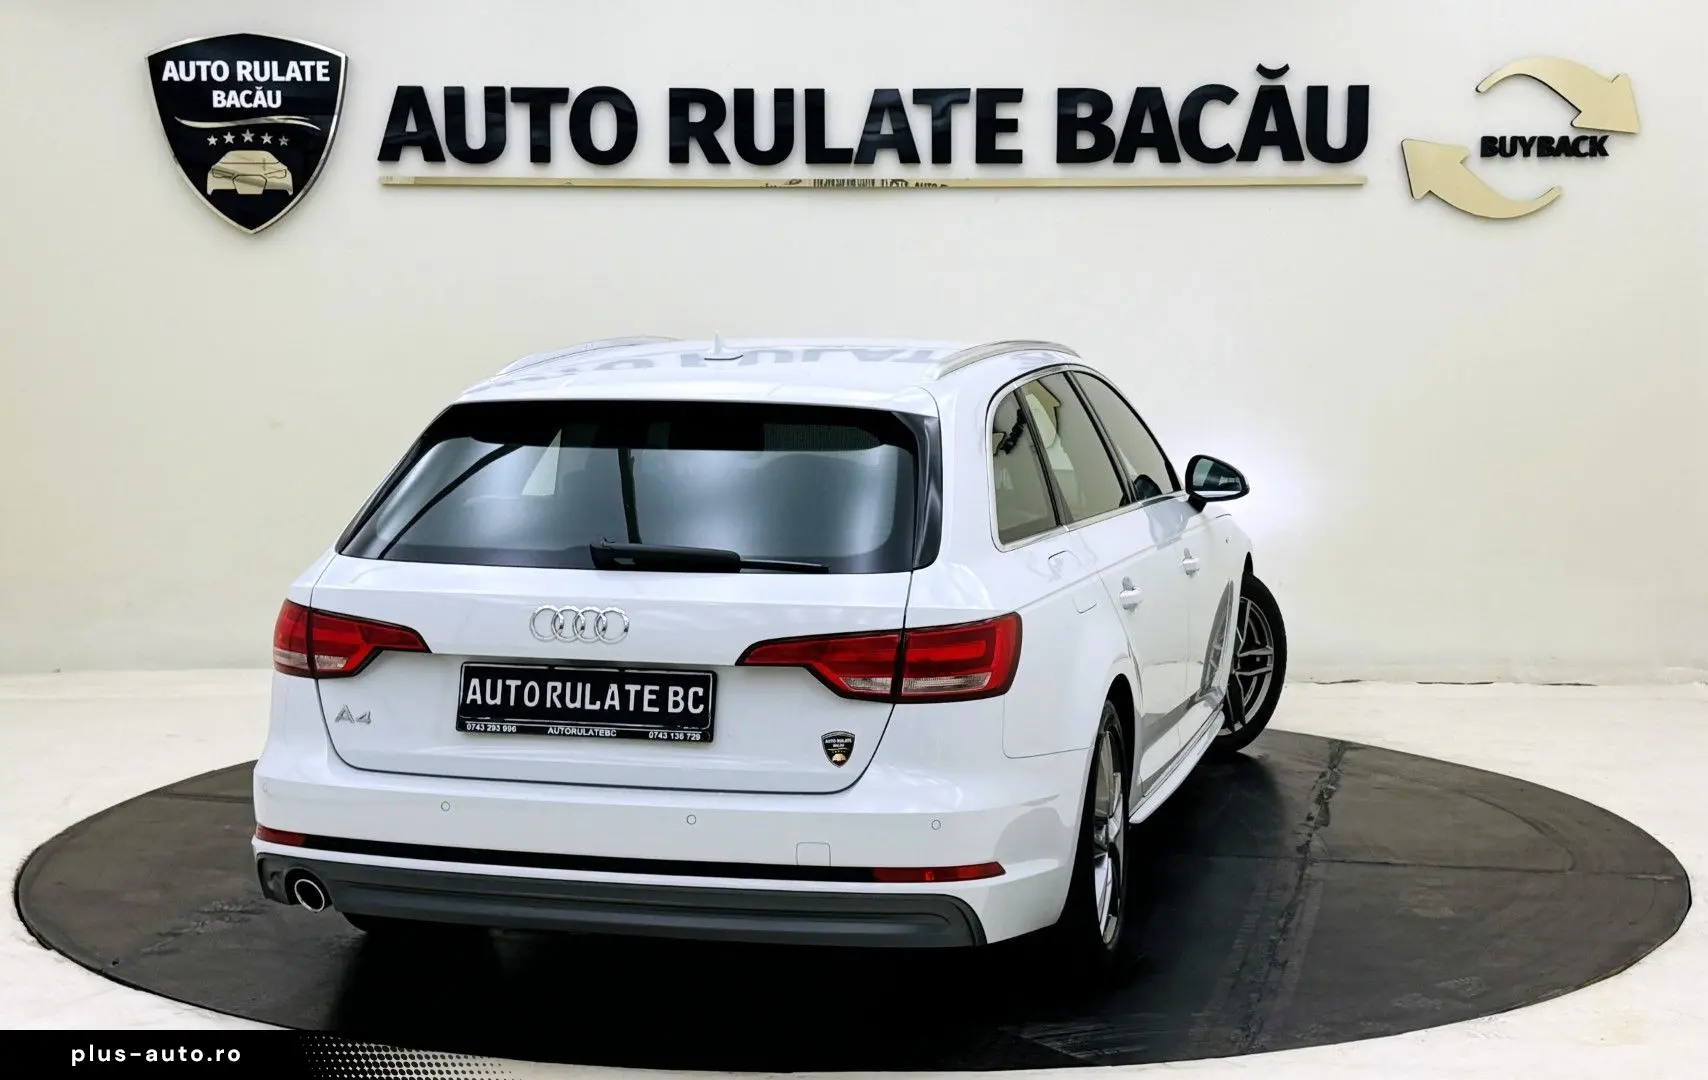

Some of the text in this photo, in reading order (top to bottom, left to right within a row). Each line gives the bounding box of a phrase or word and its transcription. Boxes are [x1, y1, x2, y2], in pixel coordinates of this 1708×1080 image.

[162, 60, 331, 82] AUTO RULATE
[212, 86, 282, 108] BACĂU
[377, 63, 1370, 166] AUTO RULATE BACĂU
[1480, 135, 1610, 158] BUYBACK
[466, 678, 704, 714] AUTO RULATE BC
[335, 704, 371, 725] A4
[466, 723, 485, 732] 0743
[547, 727, 617, 738] AUTORULATEBC
[648, 731, 668, 740] 0743
